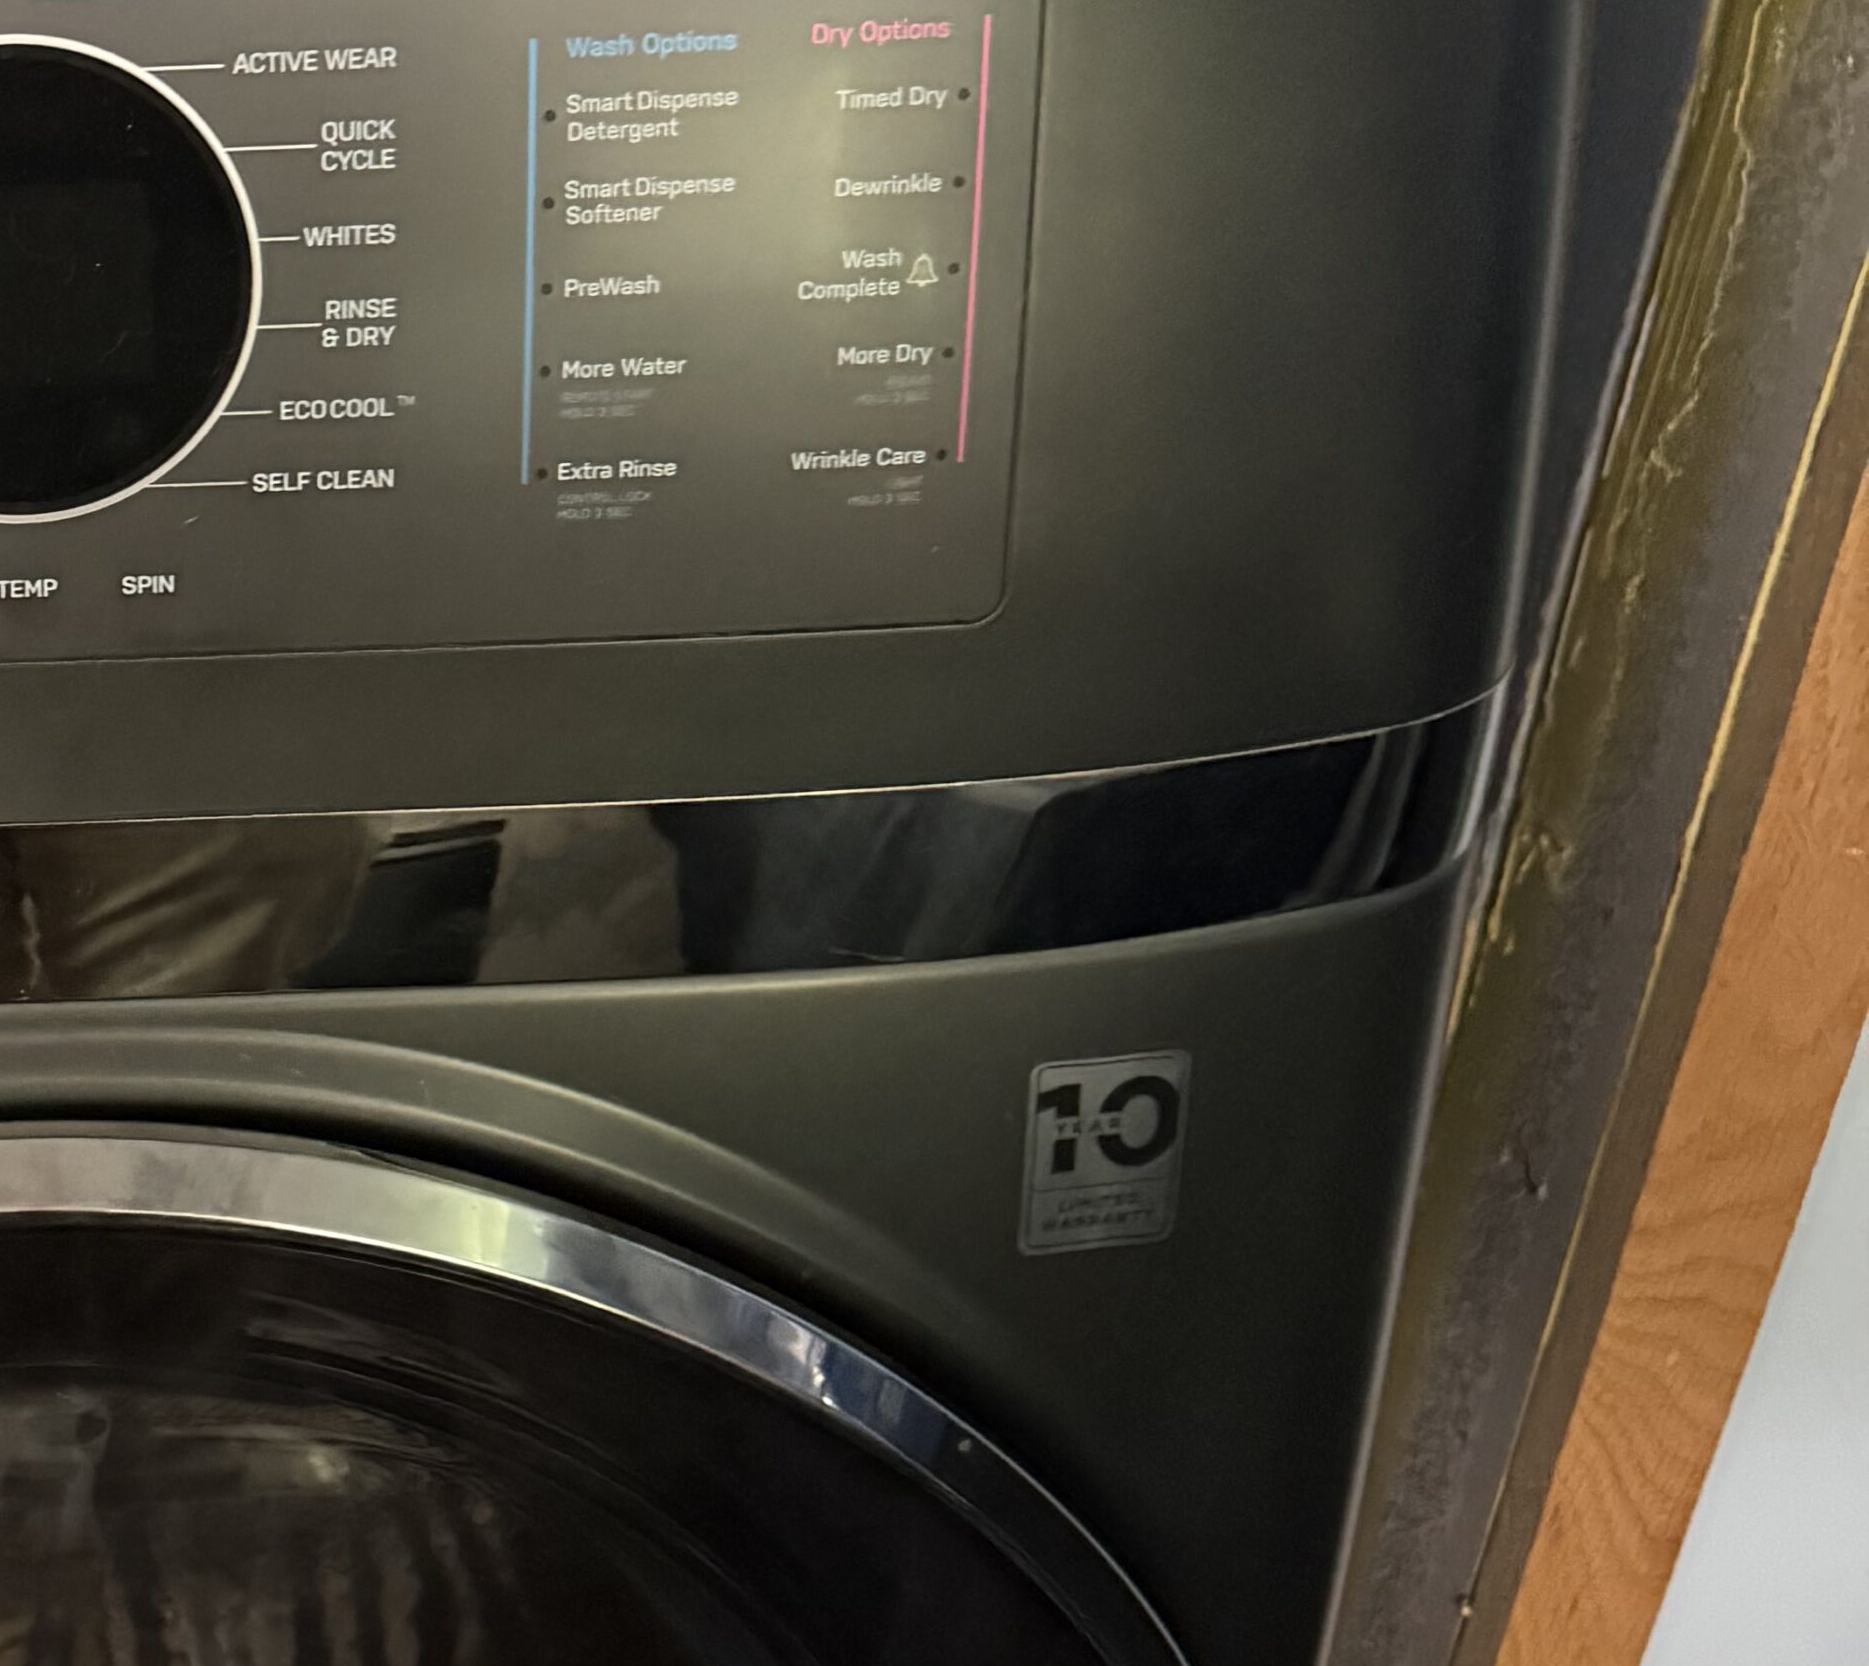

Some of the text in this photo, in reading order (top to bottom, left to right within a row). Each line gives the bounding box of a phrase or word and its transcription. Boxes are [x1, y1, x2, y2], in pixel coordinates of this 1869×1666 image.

[565, 30, 739, 59] Wash Options
[811, 17, 952, 48] Dry Options
[232, 46, 398, 75] ACTIVE WEAR
[565, 89, 740, 115] Smart Dispense
[834, 86, 949, 110] Timed Dry
[320, 118, 397, 147] QUICK
[566, 117, 680, 144] Detergent
[320, 148, 397, 172] CYCLE
[563, 176, 737, 201] Smart Dispense
[833, 172, 944, 198] Dewrinkle
[565, 203, 665, 226] Softener
[302, 223, 397, 248] WHITES
[841, 247, 903, 269] Wash
[563, 274, 661, 298] PreWash
[797, 277, 901, 303] Complete
[324, 297, 398, 321] RINSE
[321, 325, 397, 348] & DRY
[836, 343, 934, 367] More Dry
[561, 357, 688, 380] More Water
[556, 458, 679, 482] Extra Rinse
[790, 446, 927, 471] Wrinkle Care
[251, 468, 396, 494] SELF CLEAN
[121, 574, 175, 595] SPIN
[1036, 1074, 1180, 1176] 10
